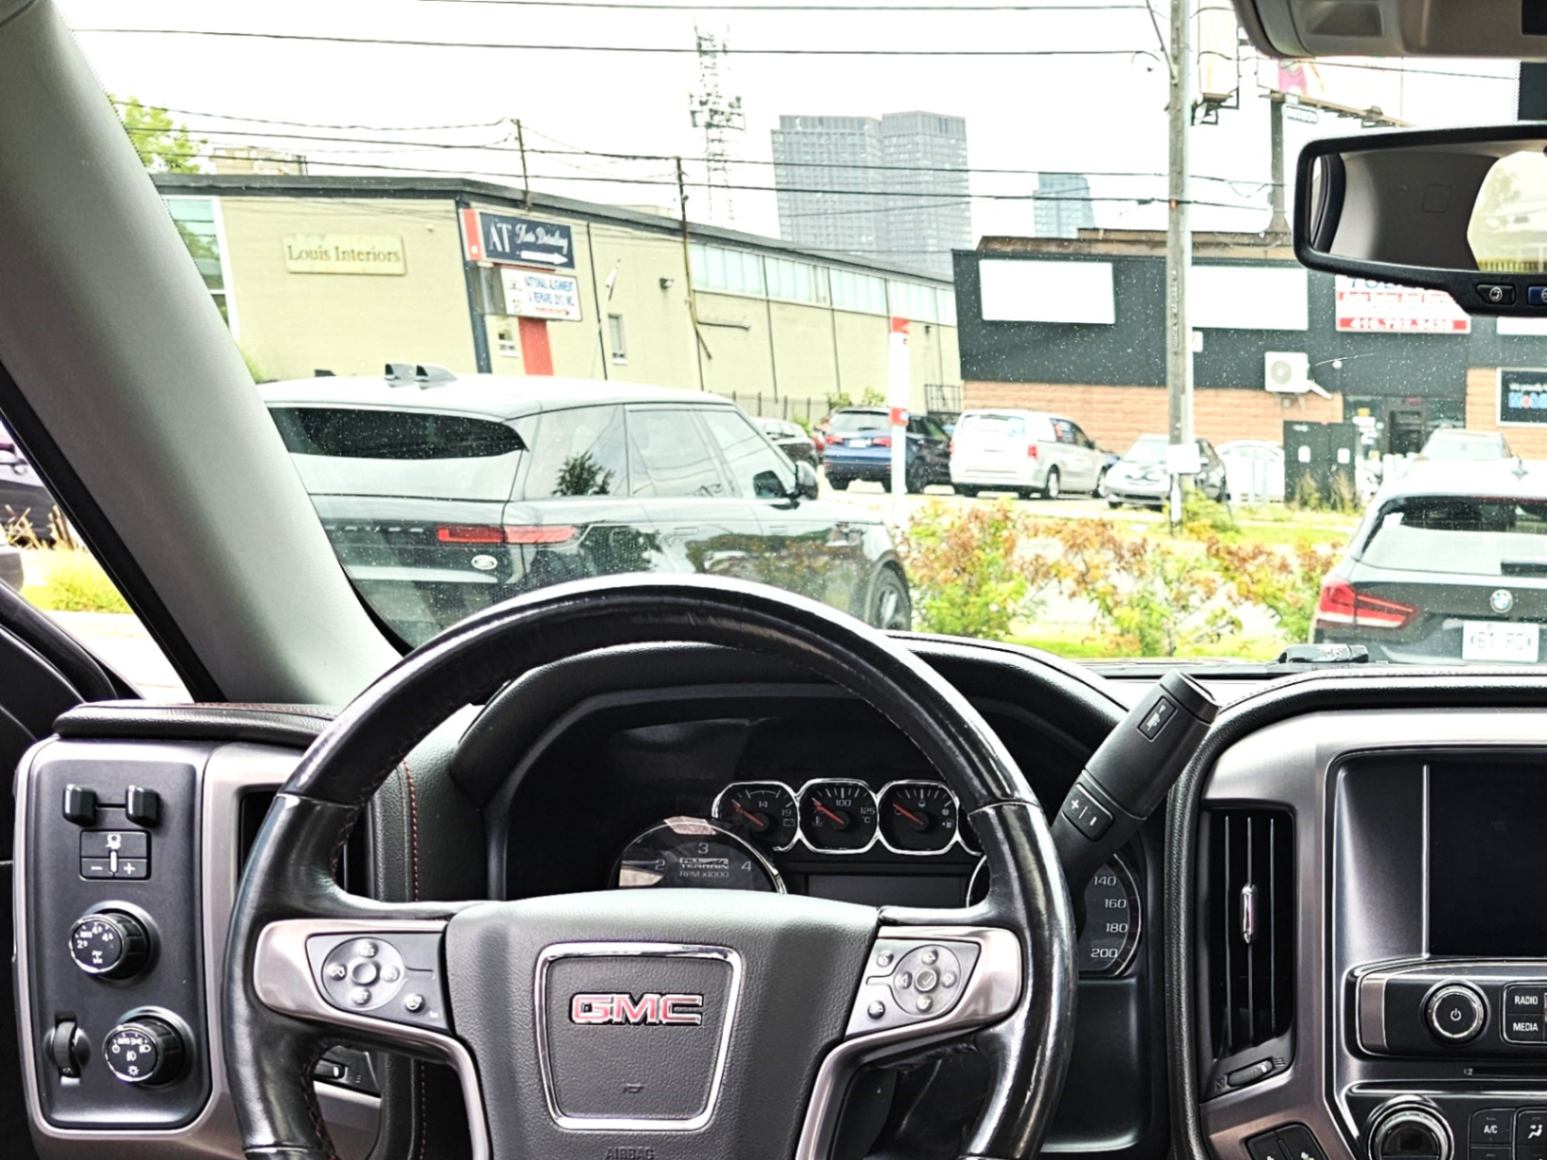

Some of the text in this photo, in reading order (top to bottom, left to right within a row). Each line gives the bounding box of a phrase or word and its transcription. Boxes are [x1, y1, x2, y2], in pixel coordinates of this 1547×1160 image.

[489, 221, 512, 253] AT
[287, 244, 401, 262] Louis Interiors
[835, 799, 851, 808] 100
[860, 807, 876, 816] 125
[698, 842, 709, 854] 3
[654, 859, 666, 871] 2
[741, 860, 752, 872] 4
[1093, 876, 1117, 886] 140
[1104, 898, 1127, 909] 160
[1106, 922, 1128, 933] 180
[1090, 947, 1118, 958] 200
[1514, 995, 1539, 1006] RADIO
[570, 992, 704, 1026] GMC
[1513, 1022, 1539, 1032] MEDIA
[1483, 1125, 1498, 1134] A/C
[605, 1146, 655, 1160] AIRBAG
